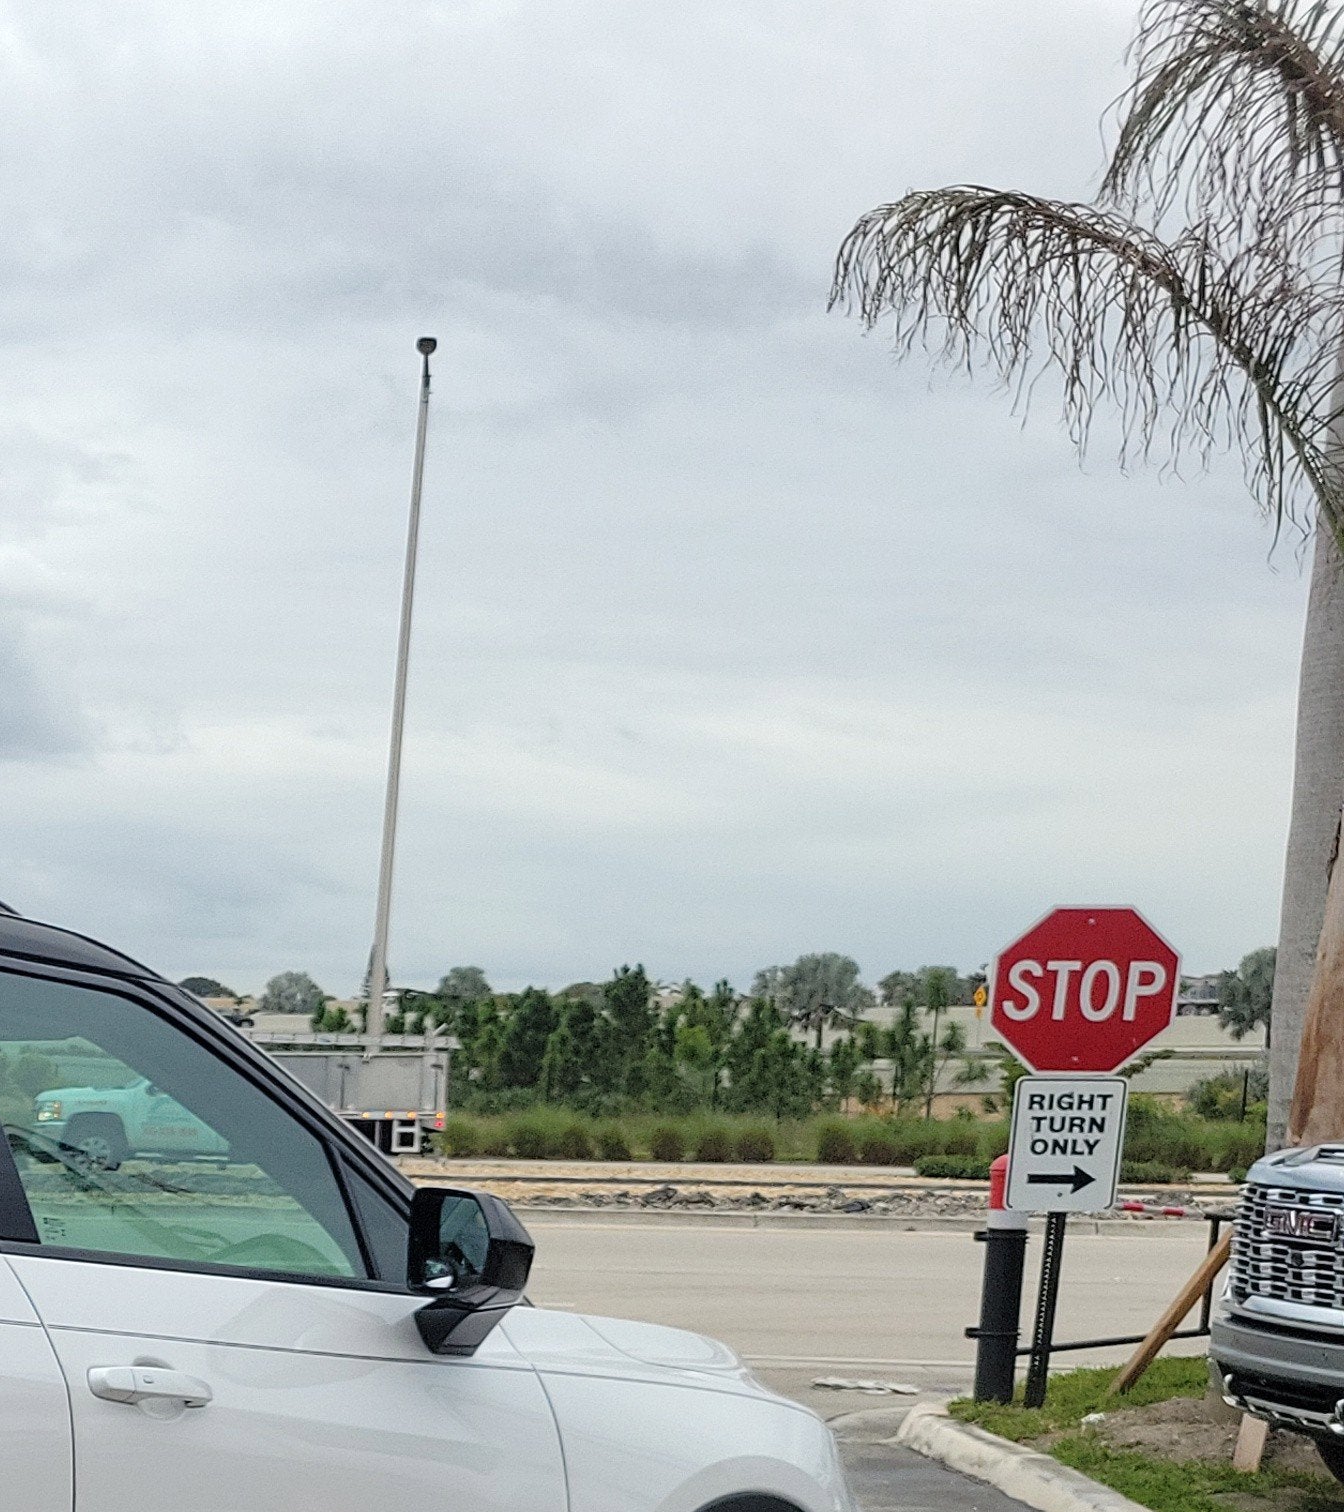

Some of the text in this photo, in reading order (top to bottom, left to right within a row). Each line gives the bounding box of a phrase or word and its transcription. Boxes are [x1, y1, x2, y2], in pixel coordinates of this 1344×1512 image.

[1002, 960, 1167, 1022] STOP
[1028, 1092, 1113, 1111] RIGHT
[1030, 1116, 1106, 1134] TURN
[1030, 1138, 1101, 1156] ONLY
[1264, 1208, 1335, 1241] GMC
